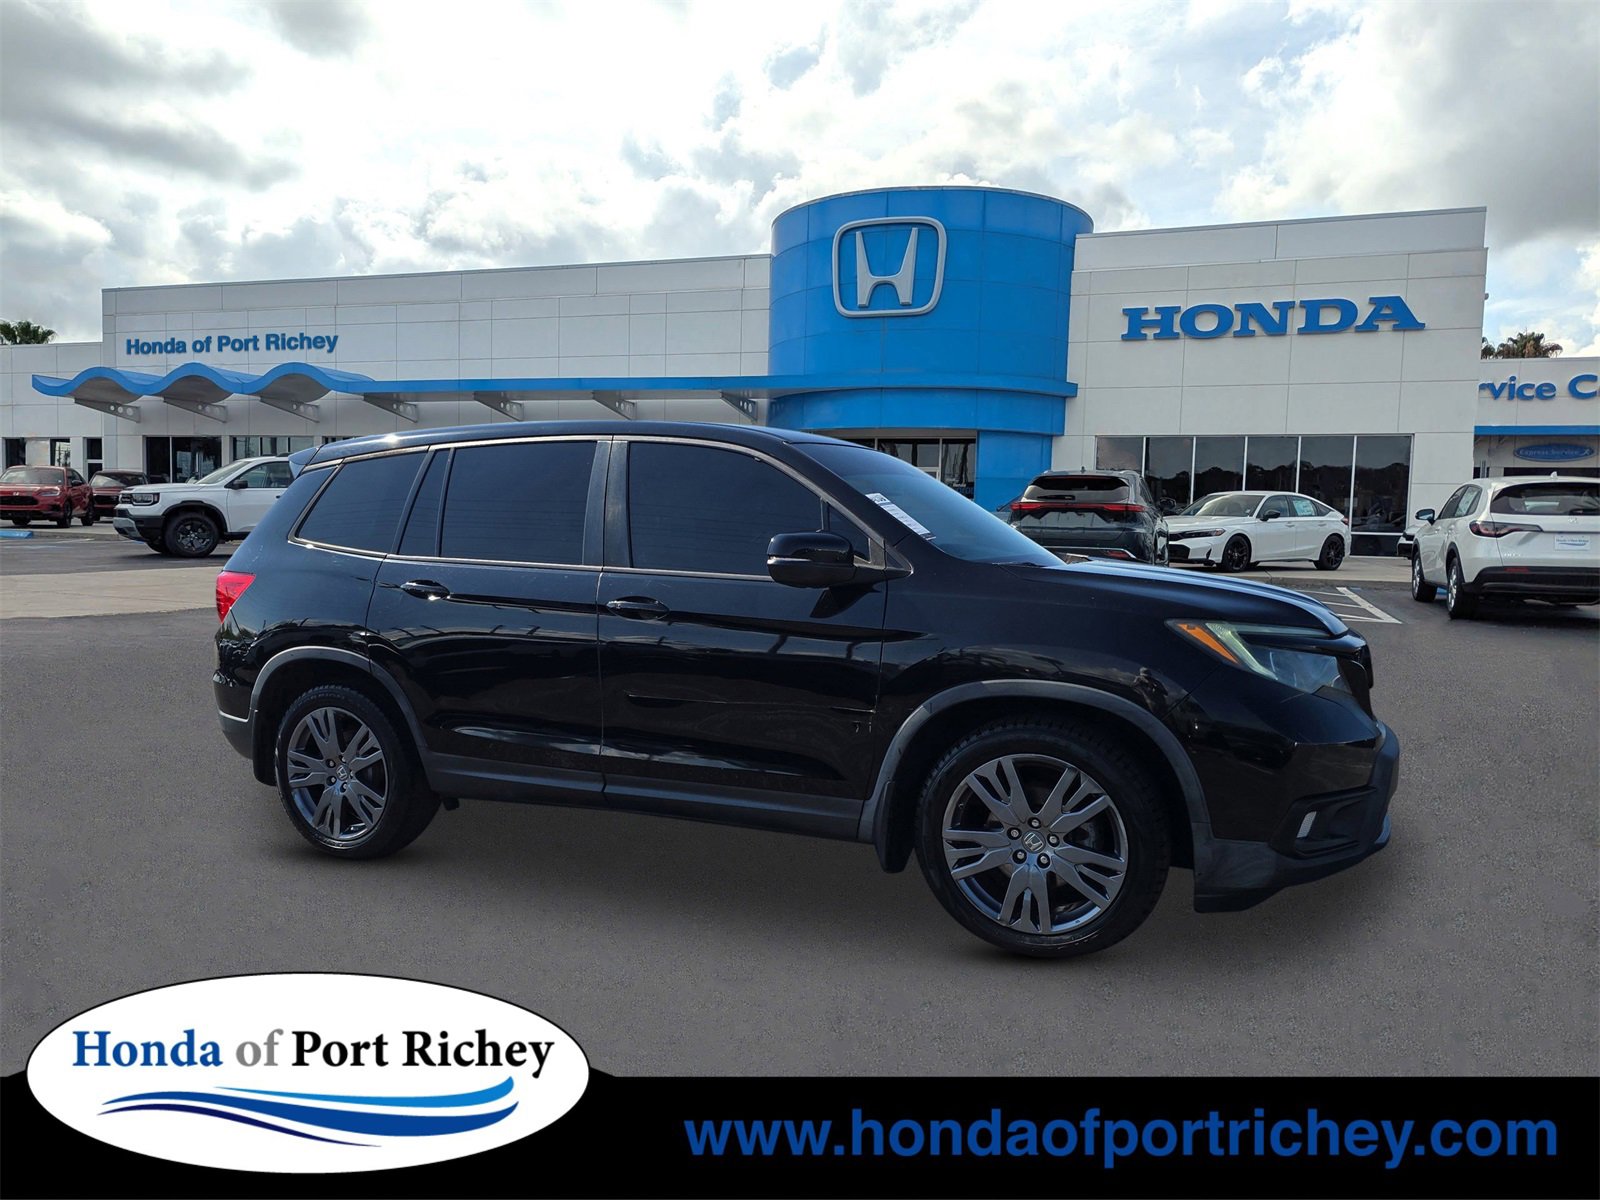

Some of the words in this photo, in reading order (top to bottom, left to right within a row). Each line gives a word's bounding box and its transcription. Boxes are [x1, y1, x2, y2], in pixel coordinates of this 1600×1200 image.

[1120, 295, 1426, 341] HONDA
[126, 337, 187, 355] Honda
[192, 335, 212, 353] of
[217, 335, 259, 353] Port
[265, 332, 338, 353] Richey
